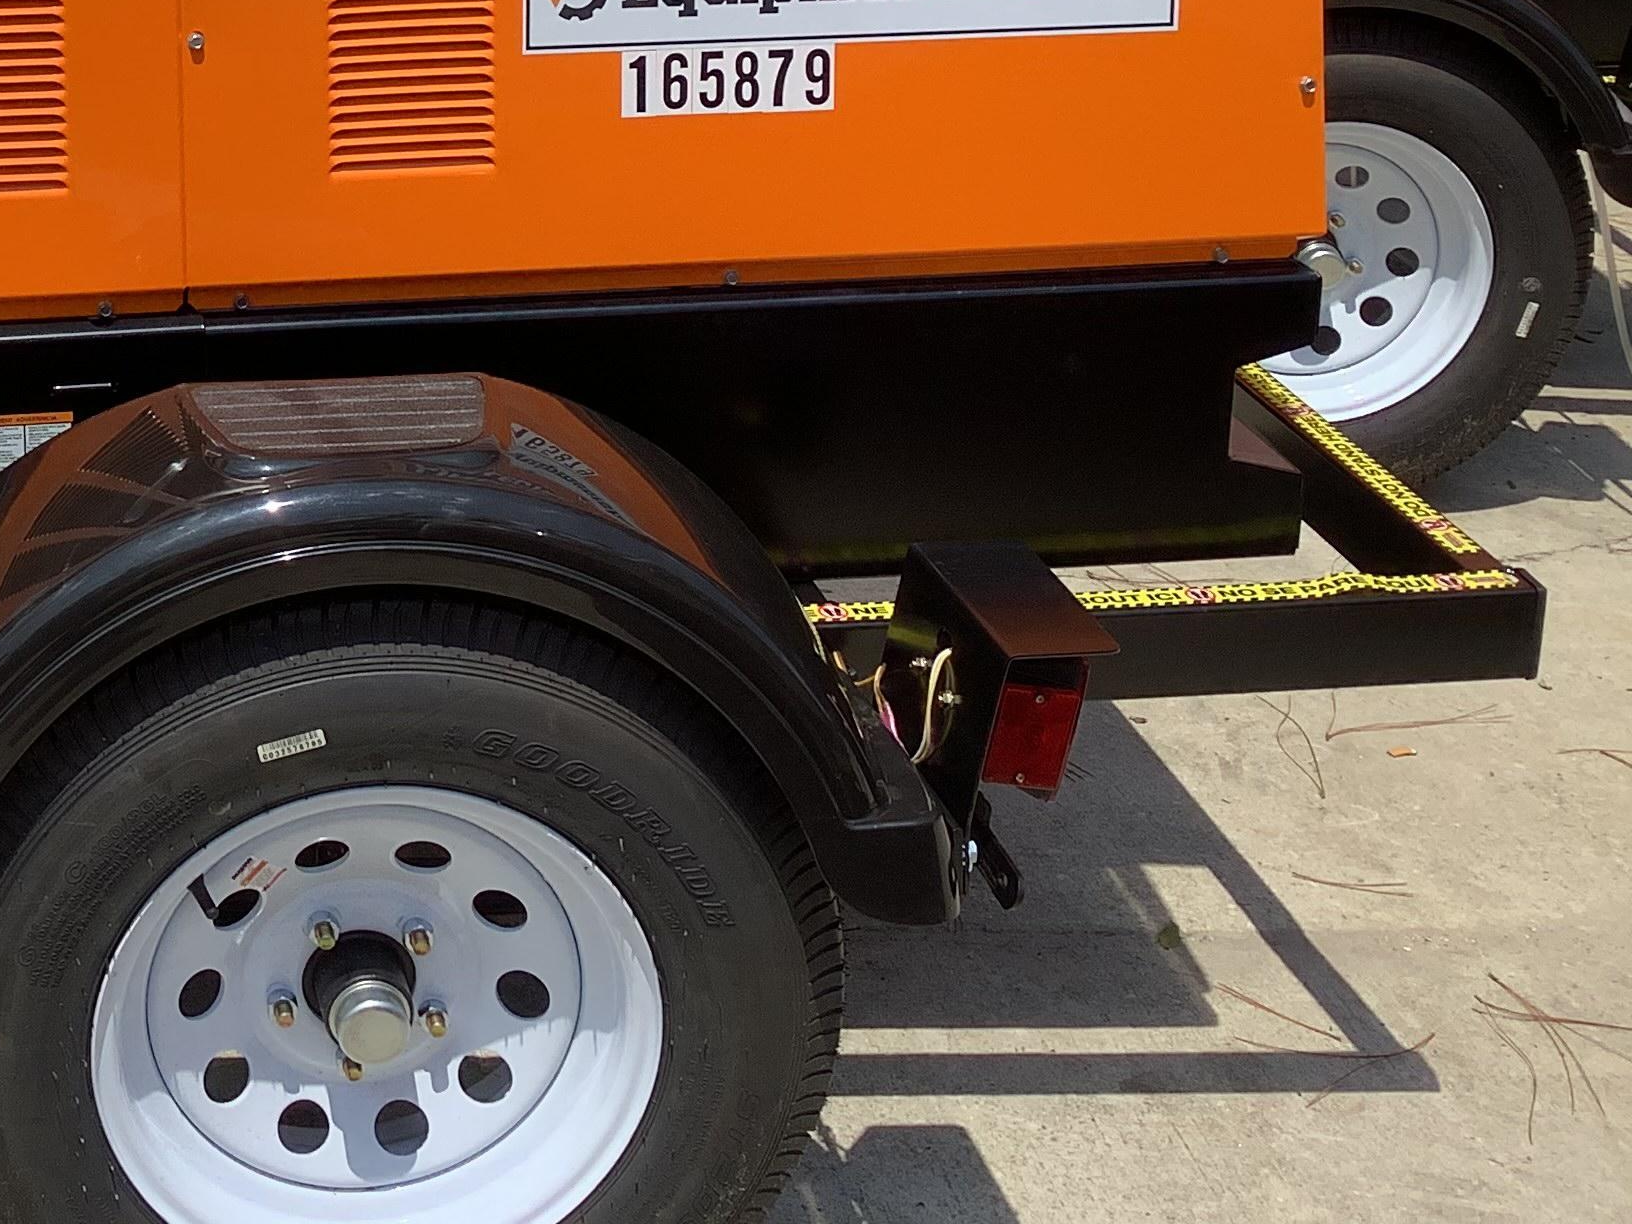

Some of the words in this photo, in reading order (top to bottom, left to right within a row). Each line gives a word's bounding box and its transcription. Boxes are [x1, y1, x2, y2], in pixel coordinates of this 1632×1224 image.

[628, 47, 833, 114] 165879
[1145, 591, 1182, 602] ICI
[1217, 587, 1257, 599] NO
[1263, 585, 1298, 596] SE
[1301, 575, 1366, 595] PARE
[471, 727, 736, 929] GOODRIDE
